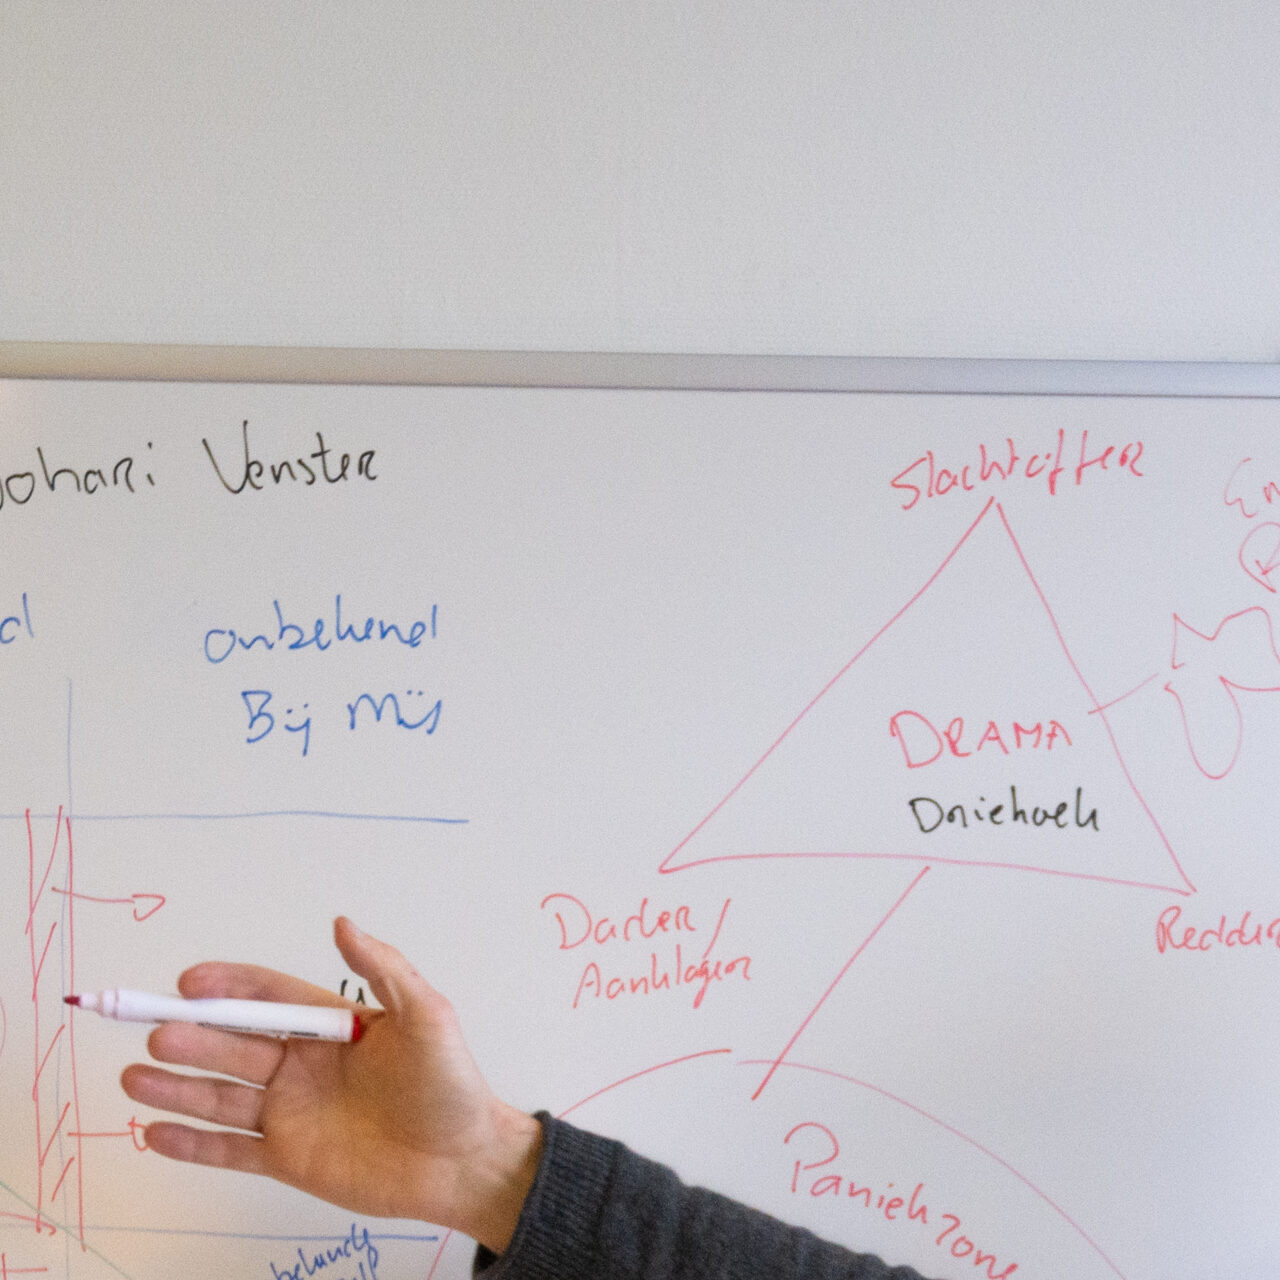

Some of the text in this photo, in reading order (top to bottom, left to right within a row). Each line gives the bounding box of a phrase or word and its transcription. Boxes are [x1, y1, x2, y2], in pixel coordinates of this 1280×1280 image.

[0, 419, 378, 511] ohari Venster
[889, 709, 1073, 769] DRAMA
